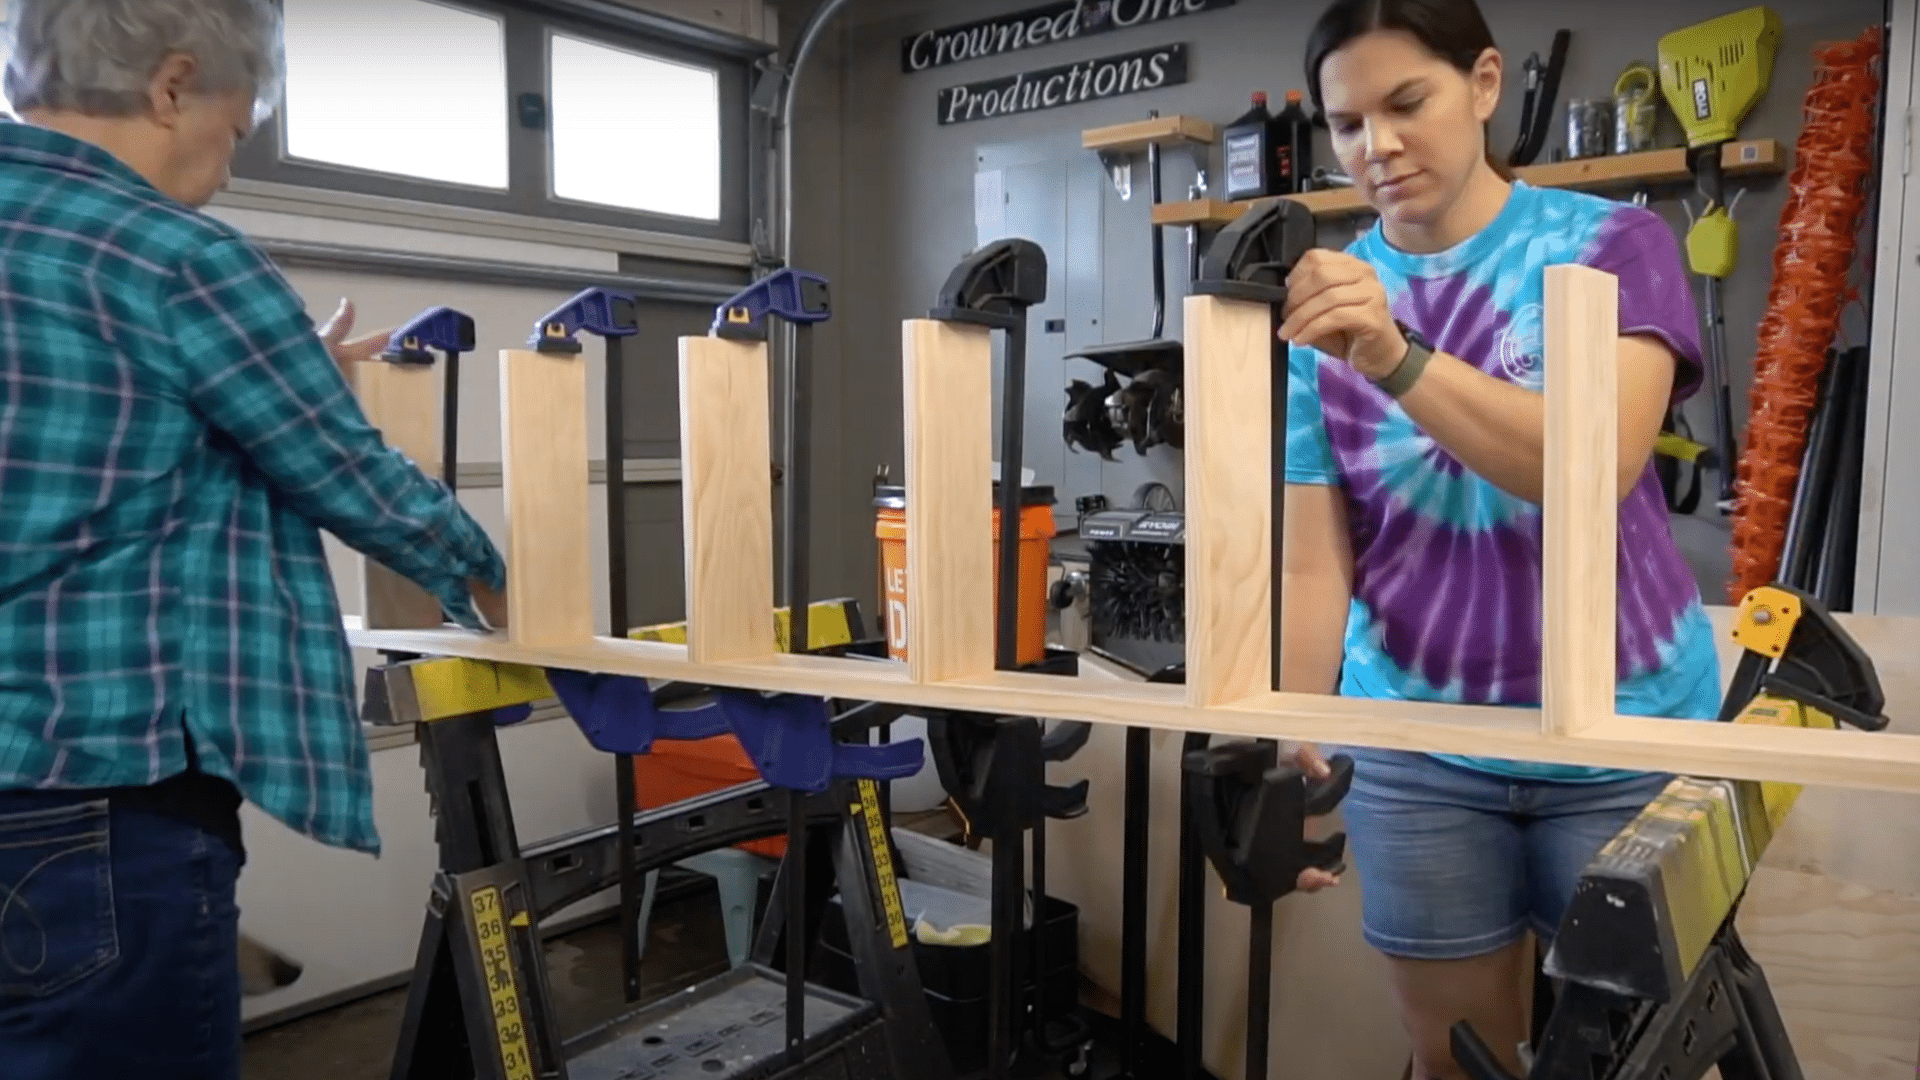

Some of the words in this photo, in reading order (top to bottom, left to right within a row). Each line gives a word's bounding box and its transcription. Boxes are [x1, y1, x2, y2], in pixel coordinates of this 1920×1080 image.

[909, 0, 1081, 70] Crowned
[945, 51, 1170, 123] Productions
[474, 891, 495, 914] 37
[479, 918, 501, 940] 36
[484, 943, 506, 967] 35
[500, 1021, 522, 1045] 32
[505, 1045, 527, 1071] 31
